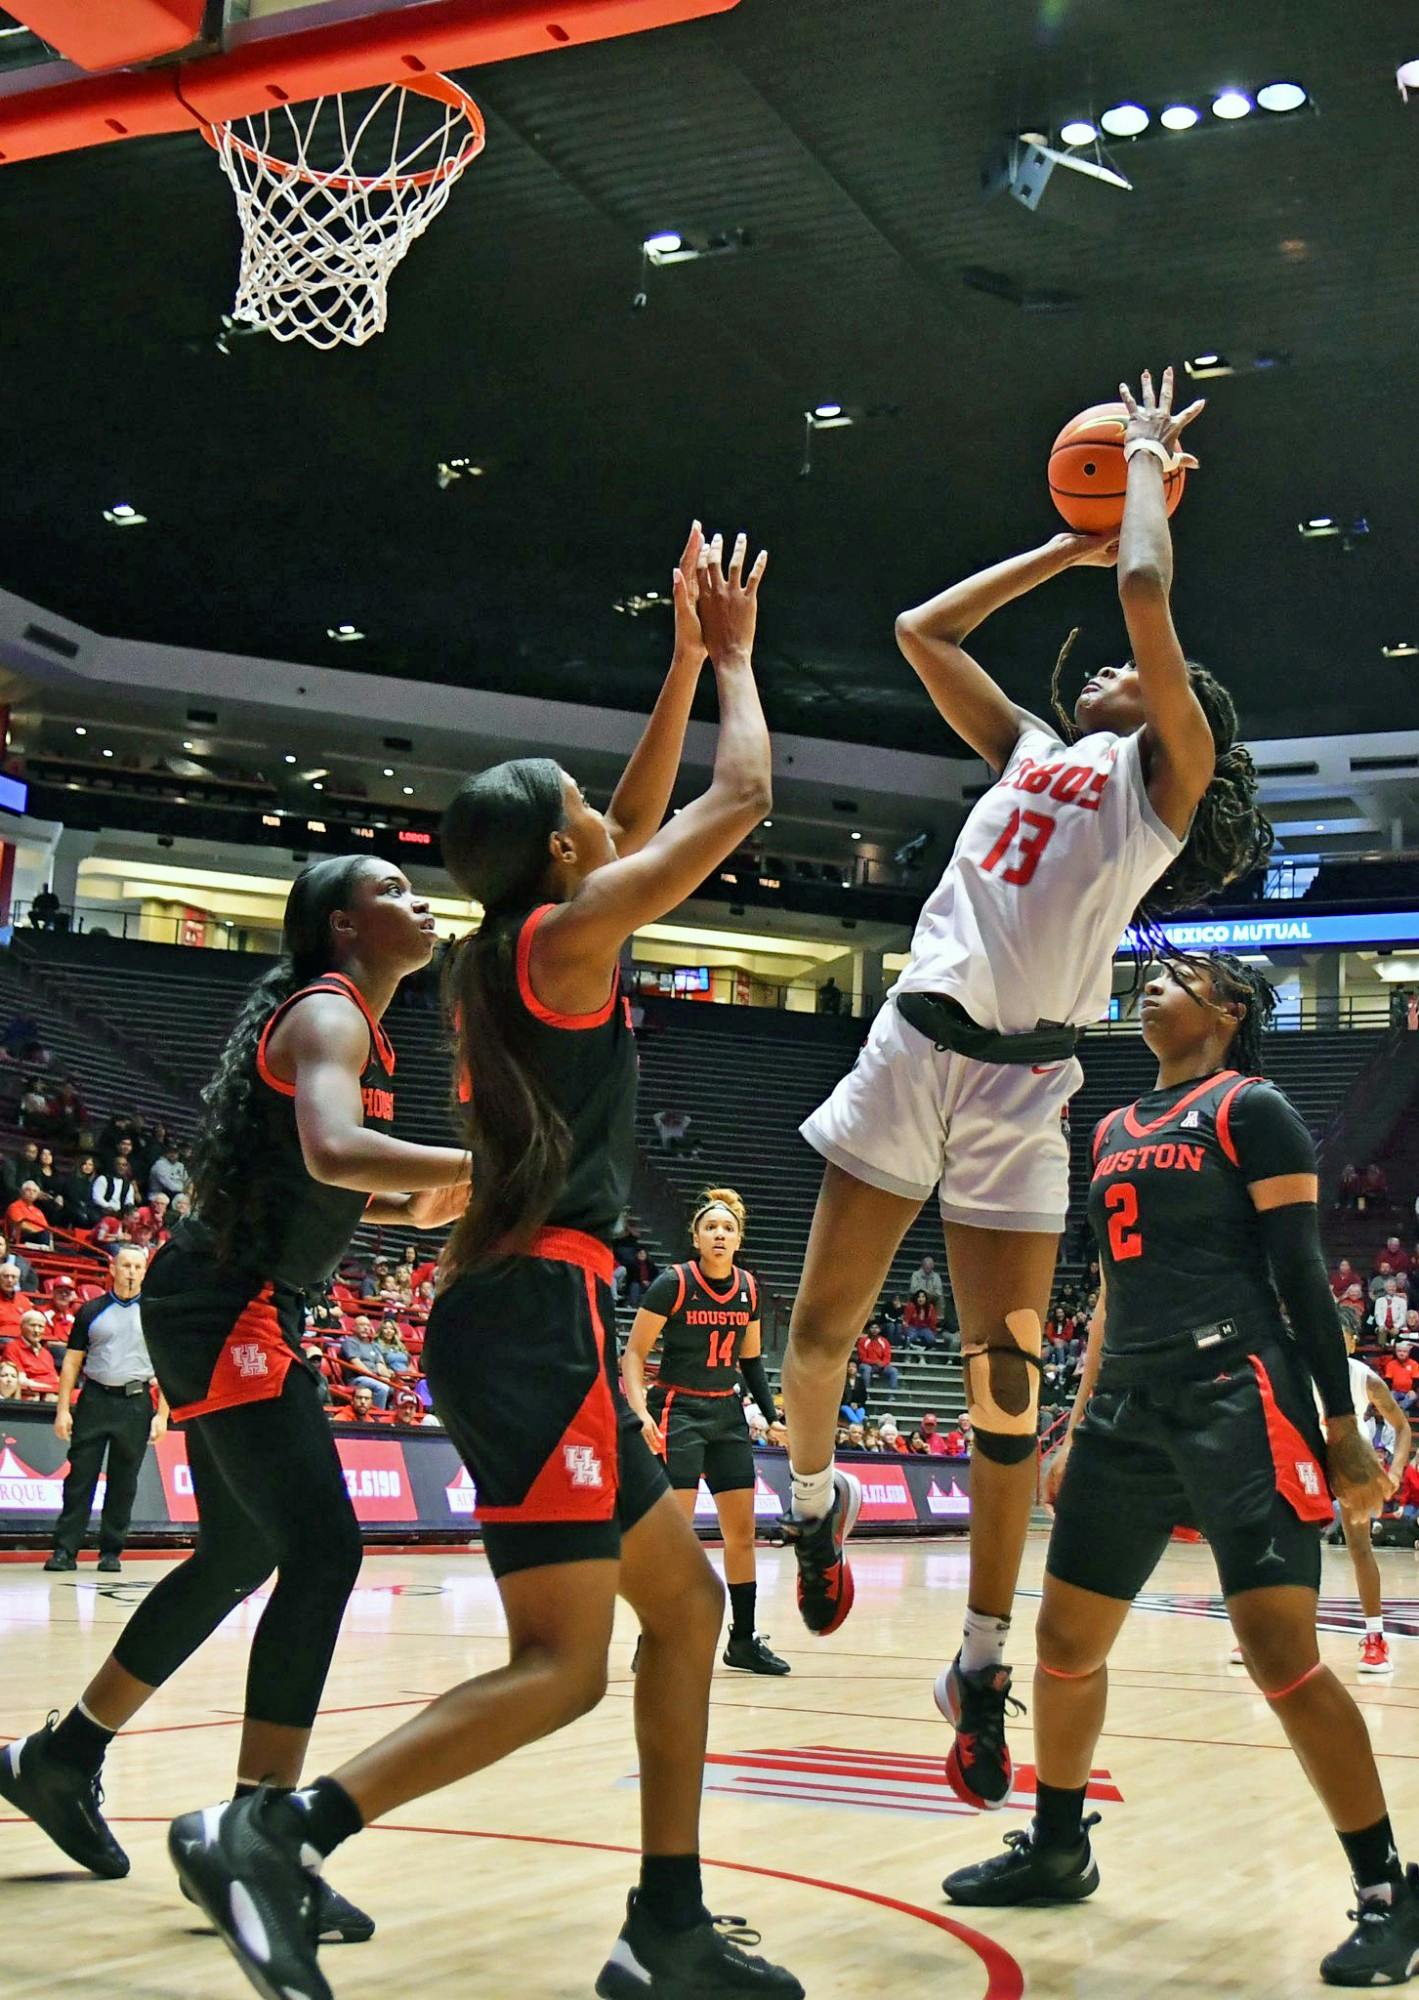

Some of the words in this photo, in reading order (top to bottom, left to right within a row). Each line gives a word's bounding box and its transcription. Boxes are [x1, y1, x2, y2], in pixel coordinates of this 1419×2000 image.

[981, 808, 1057, 885] 13
[1232, 922, 1312, 942] MUTUAL
[1105, 1182, 1142, 1262] 2
[686, 1310, 750, 1327] HOUSTON
[706, 1330, 736, 1368] 14
